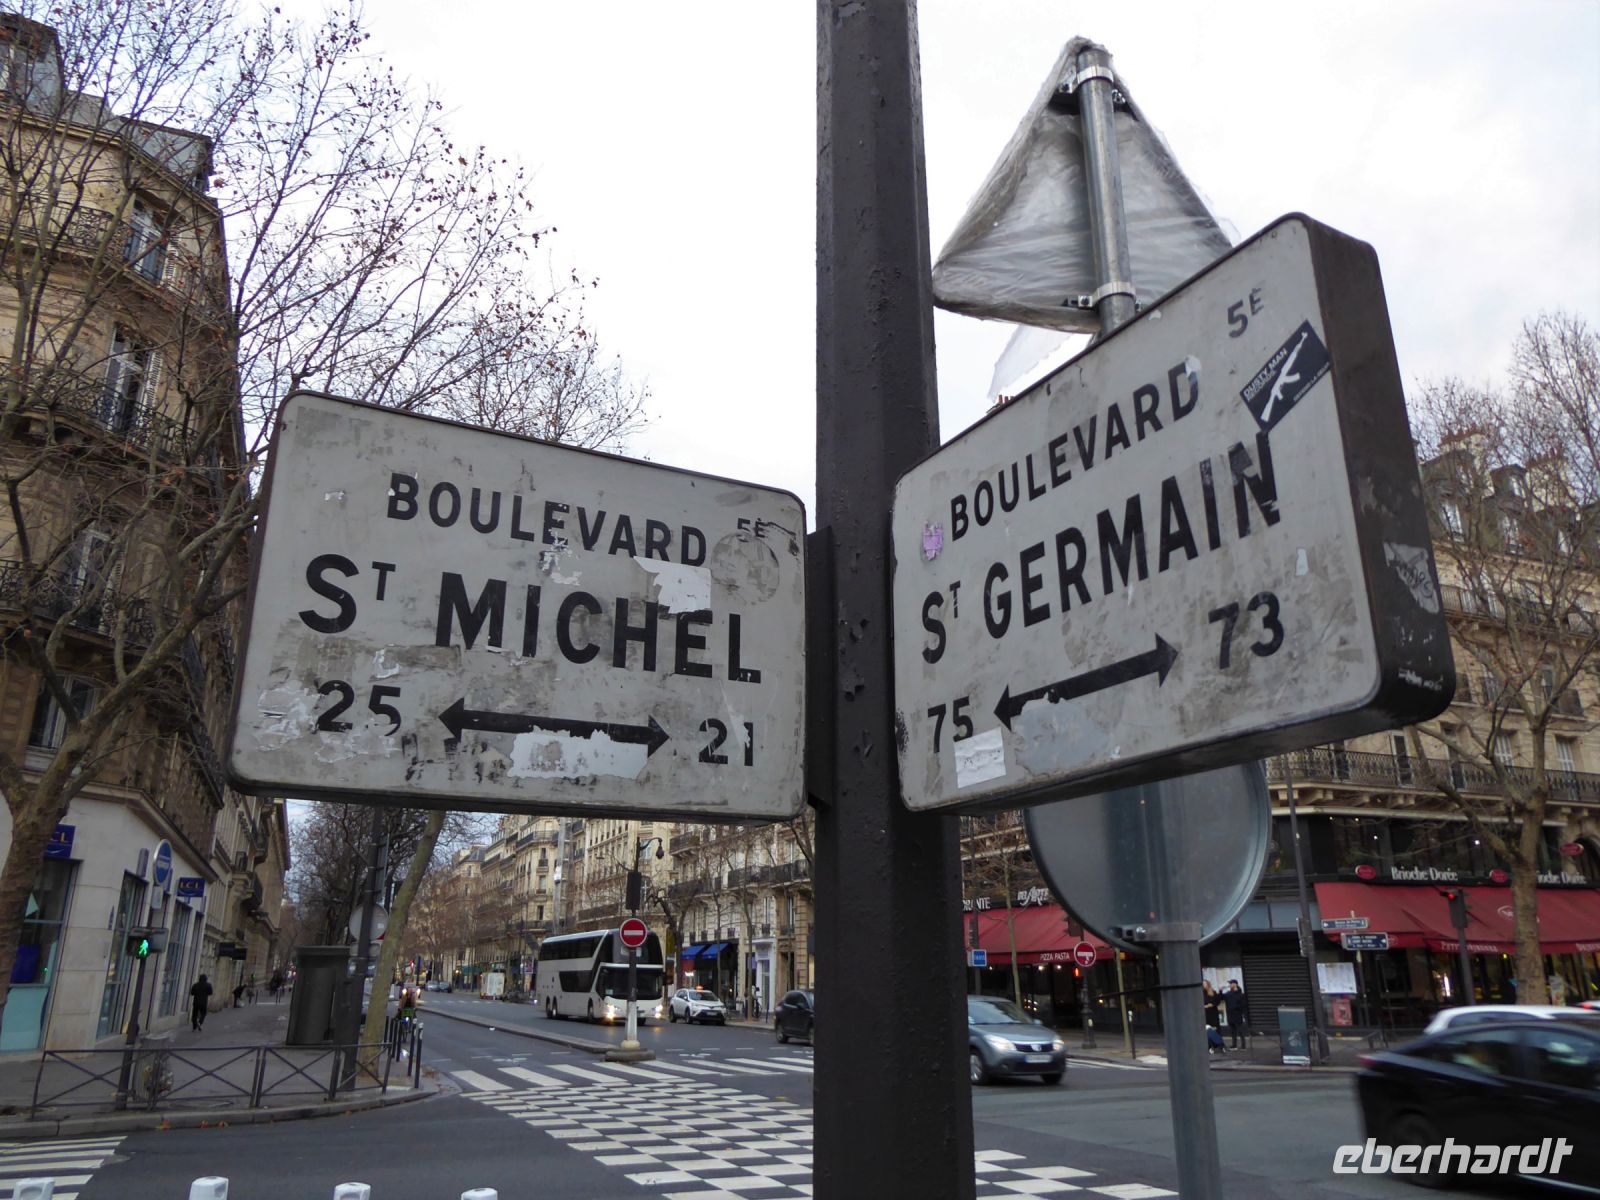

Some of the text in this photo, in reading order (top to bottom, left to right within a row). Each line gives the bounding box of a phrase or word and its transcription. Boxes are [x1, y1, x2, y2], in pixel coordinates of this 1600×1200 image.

[1243, 348, 1288, 397] DUSTY MAN
[950, 360, 1200, 543] BOULEVARD
[387, 472, 707, 568] BOULEVARD
[983, 430, 1281, 641] GERMAIN
[435, 571, 762, 685] MICHEL
[1208, 591, 1286, 670] 73
[316, 680, 402, 737] 25
[927, 696, 974, 754] 75
[698, 718, 754, 767] 21
[1391, 866, 1428, 880] Brioche
[1429, 867, 1458, 881] Dorée
[1055, 952, 1070, 960] PASTA
